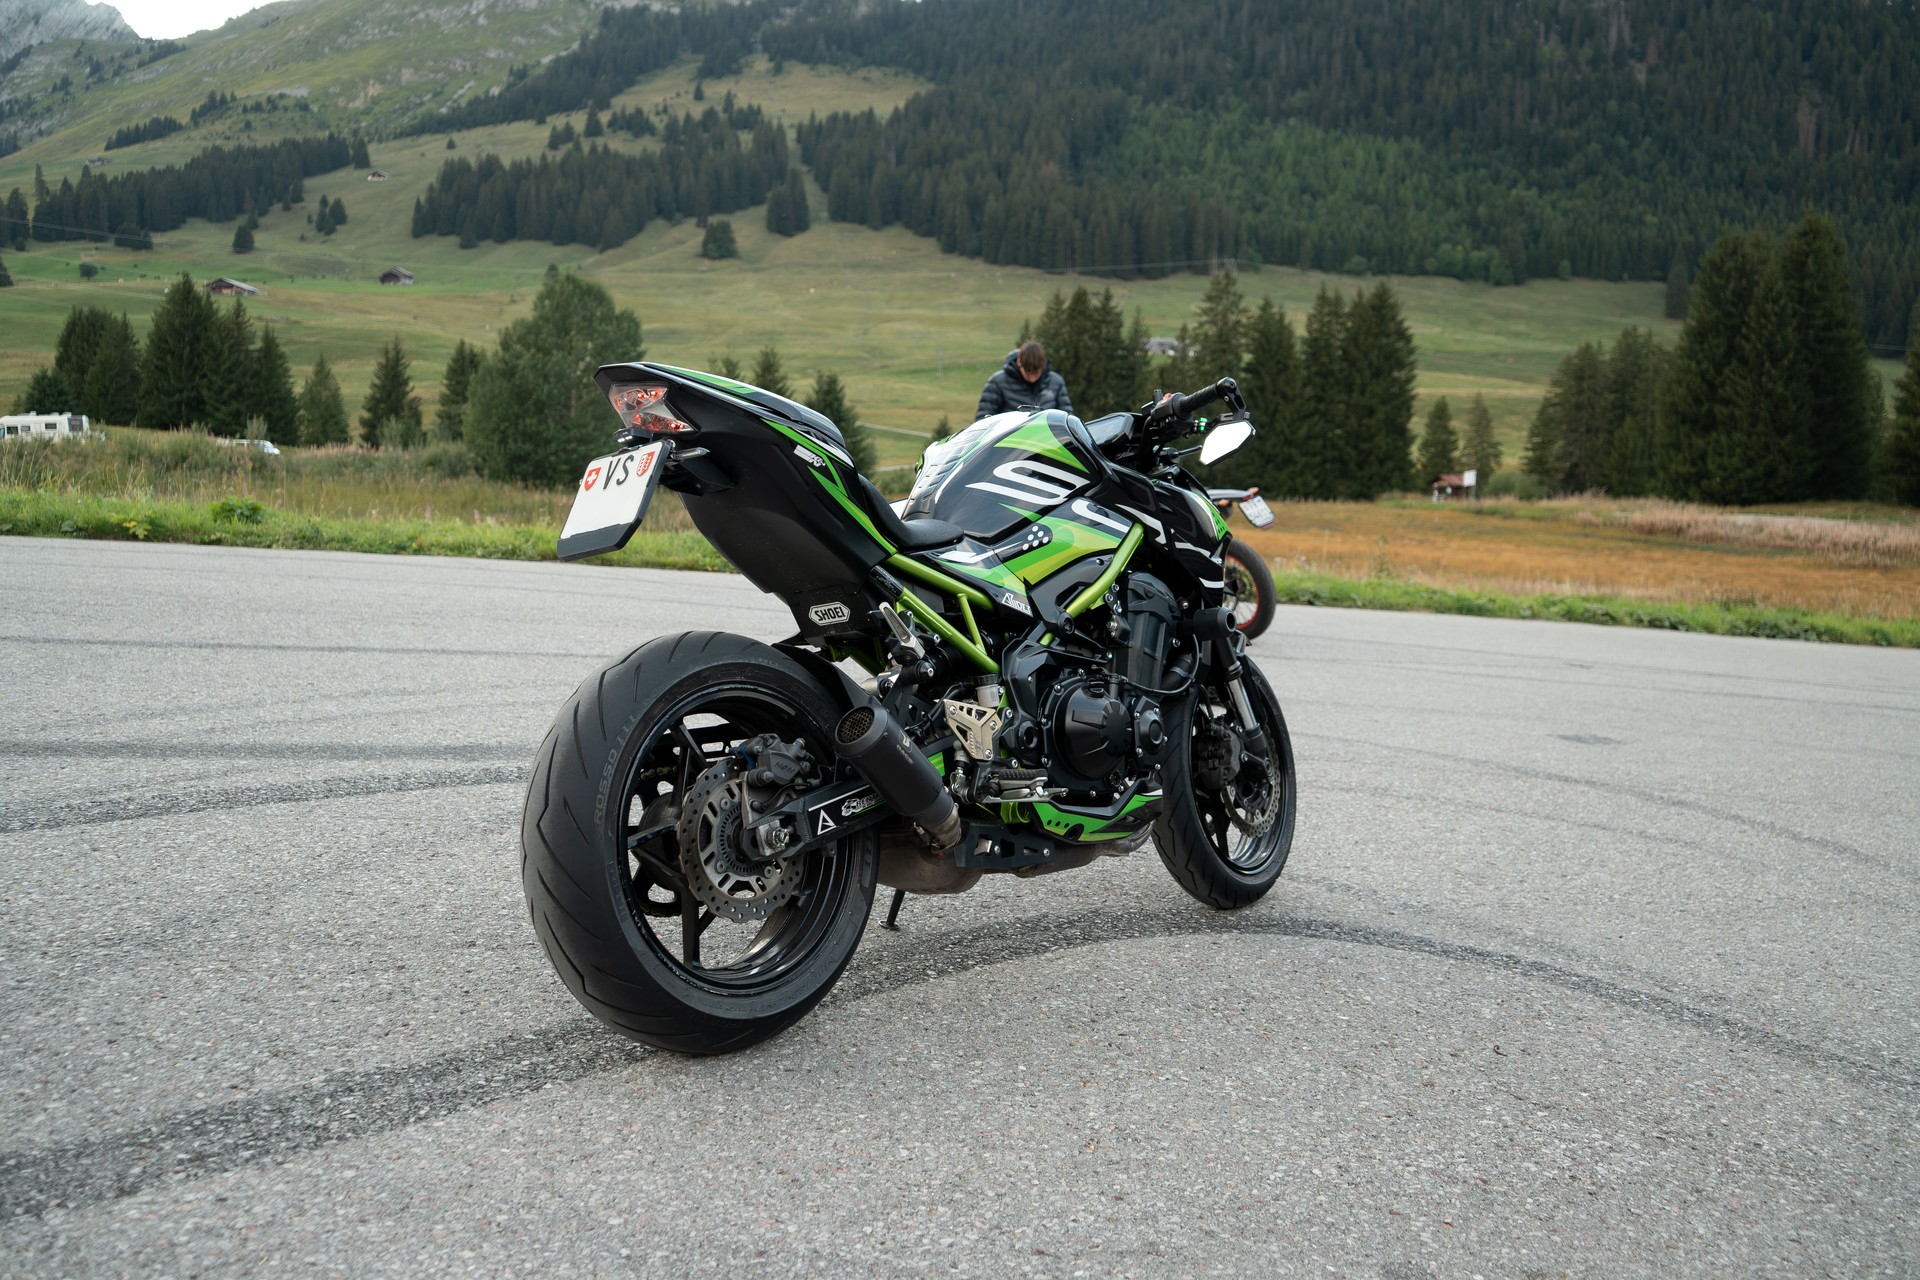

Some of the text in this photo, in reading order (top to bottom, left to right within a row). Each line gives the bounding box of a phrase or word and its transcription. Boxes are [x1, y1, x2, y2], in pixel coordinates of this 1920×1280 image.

[603, 454, 635, 490] VS
[814, 606, 846, 621] SHOEI
[593, 748, 618, 825] ROSSO
